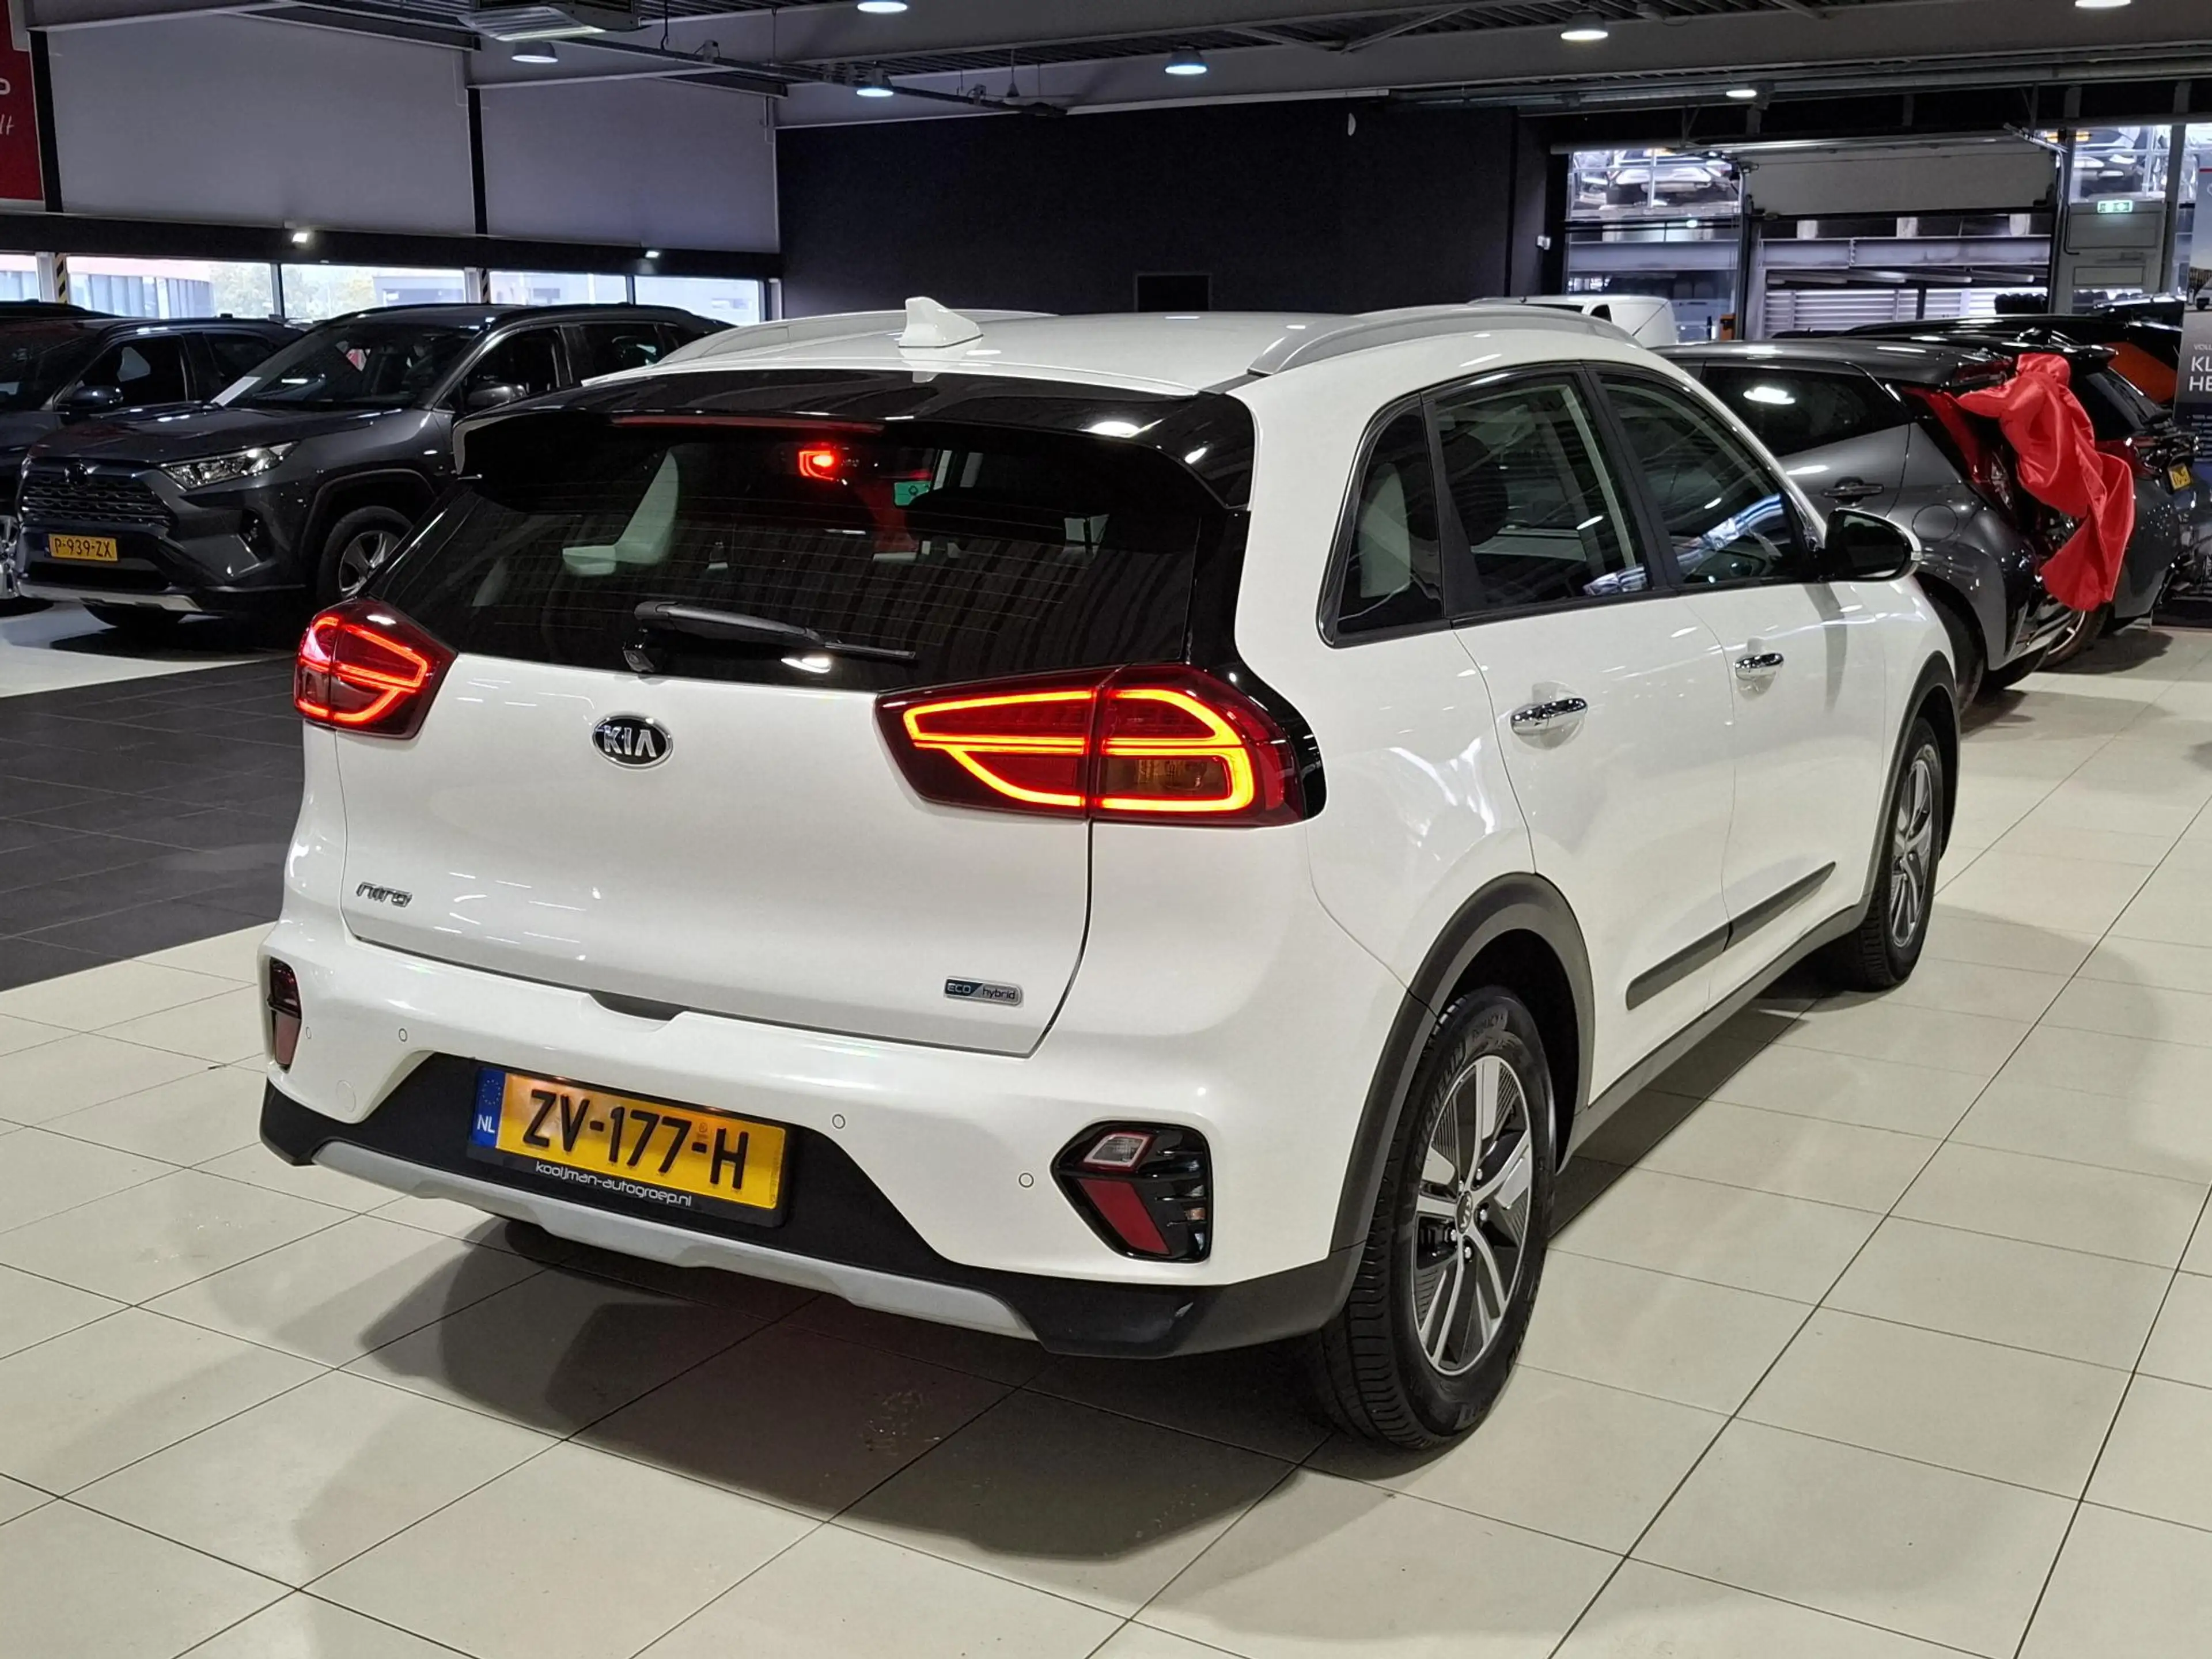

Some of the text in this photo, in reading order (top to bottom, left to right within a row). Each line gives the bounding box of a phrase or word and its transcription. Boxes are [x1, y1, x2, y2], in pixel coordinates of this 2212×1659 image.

[54, 537, 112, 558] P-939-ZX
[604, 726, 657, 757] KIA
[982, 986, 1016, 1000] hybrid
[476, 1114, 495, 1134] NL
[522, 1089, 749, 1190] ZV-177-H
[535, 1160, 692, 1207] kooijman-autogroep.nl
